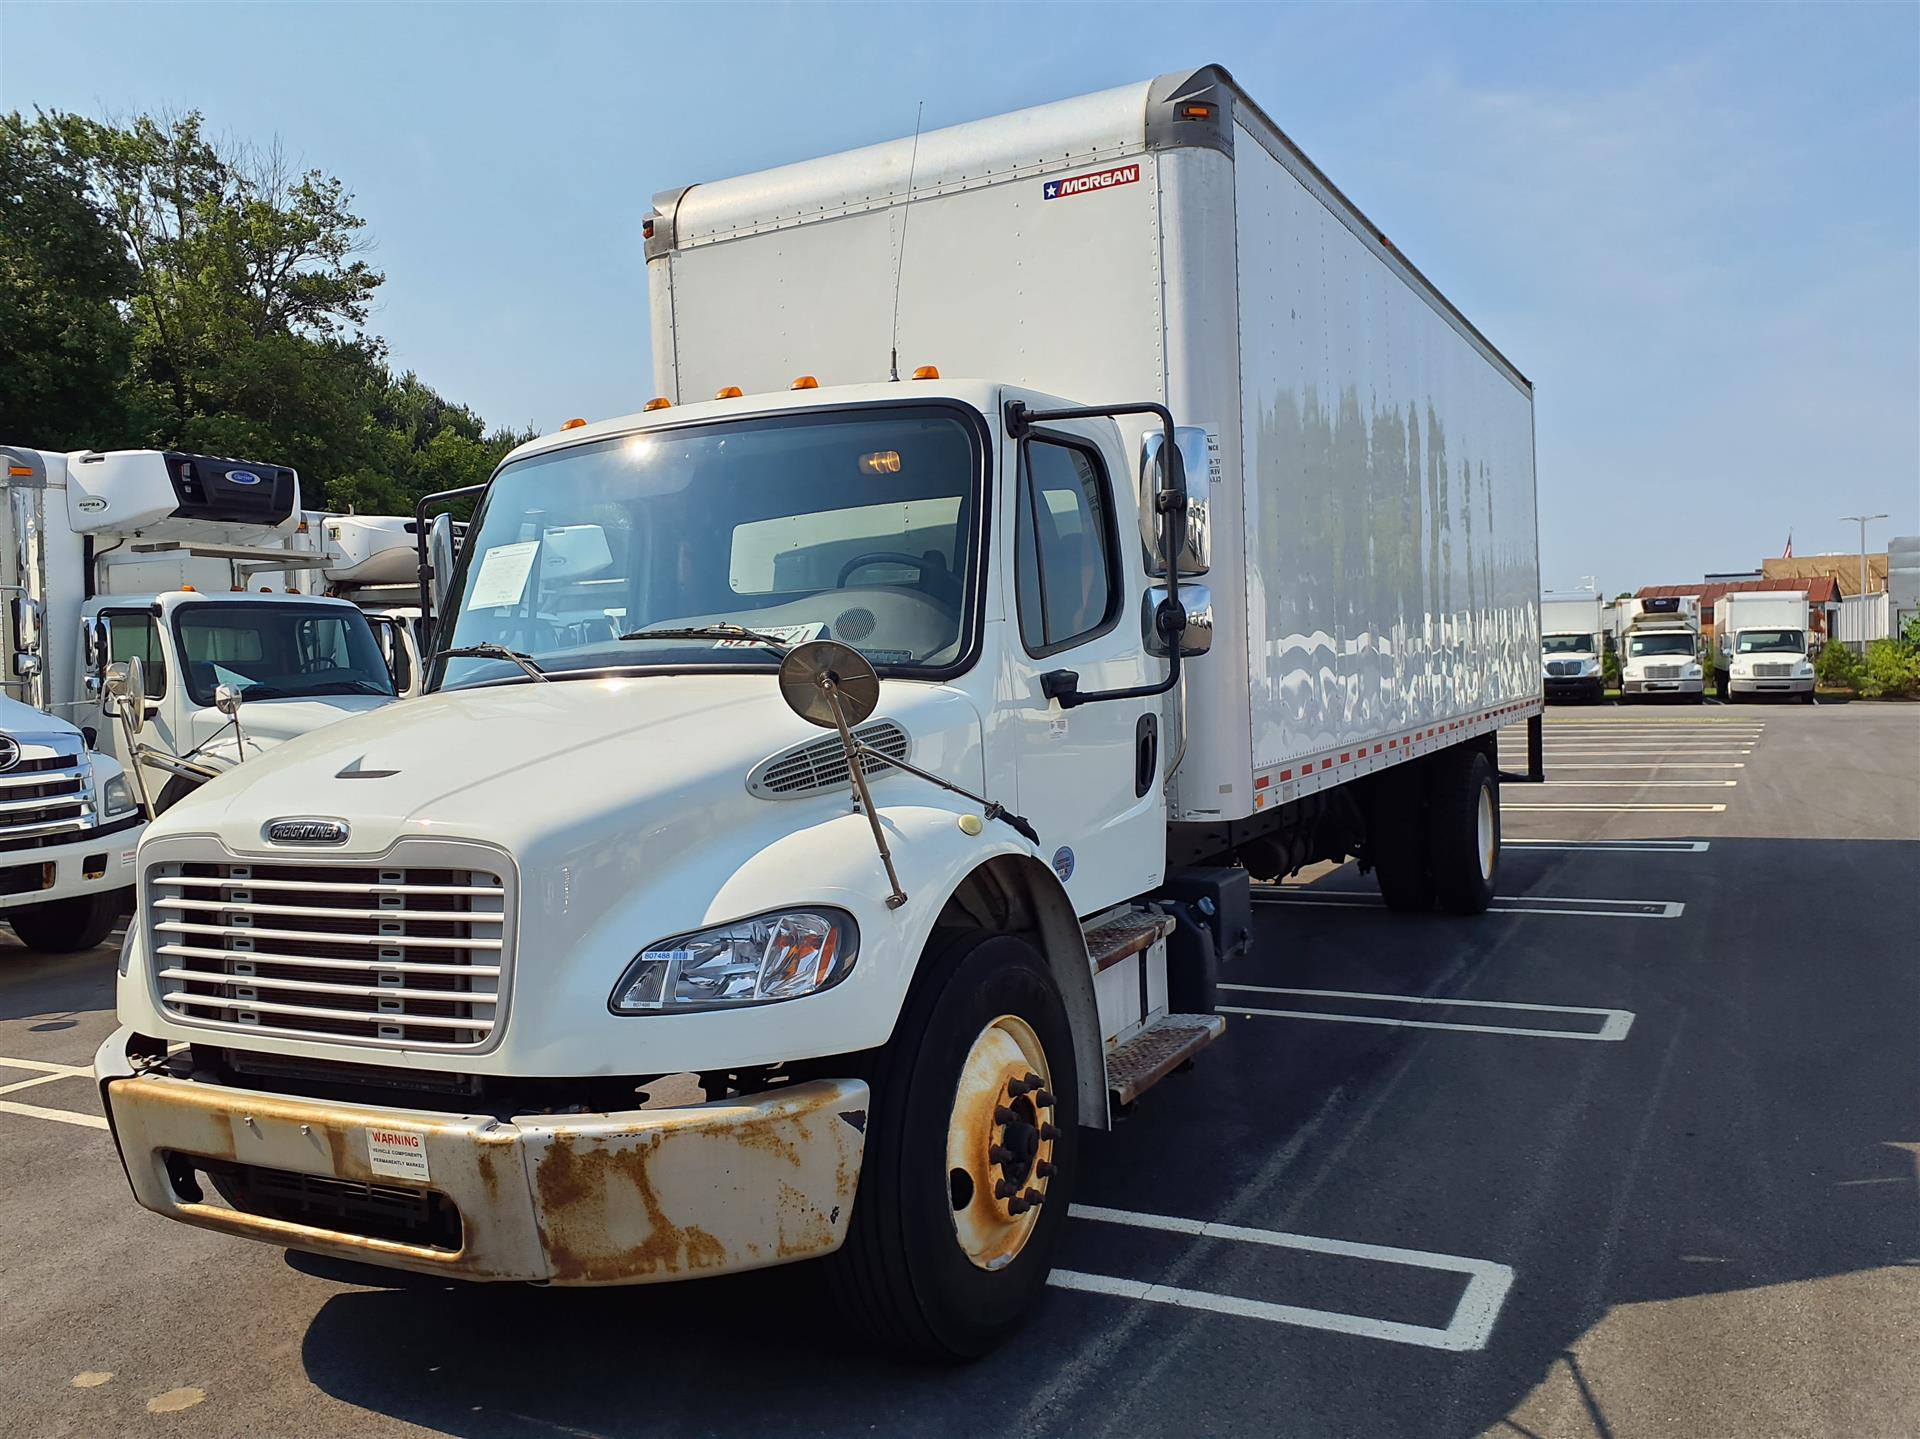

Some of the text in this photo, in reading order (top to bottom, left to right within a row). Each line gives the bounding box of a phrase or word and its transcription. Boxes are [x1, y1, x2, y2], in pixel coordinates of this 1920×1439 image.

[1060, 168, 1135, 195] MORGAN
[271, 825, 339, 838] FREIGHTLINER
[372, 1131, 419, 1148] WARNING
[373, 1147, 423, 1159] VEHICLE COMPONENTS
[373, 1157, 425, 1169] PERMANENTLY MARKED
